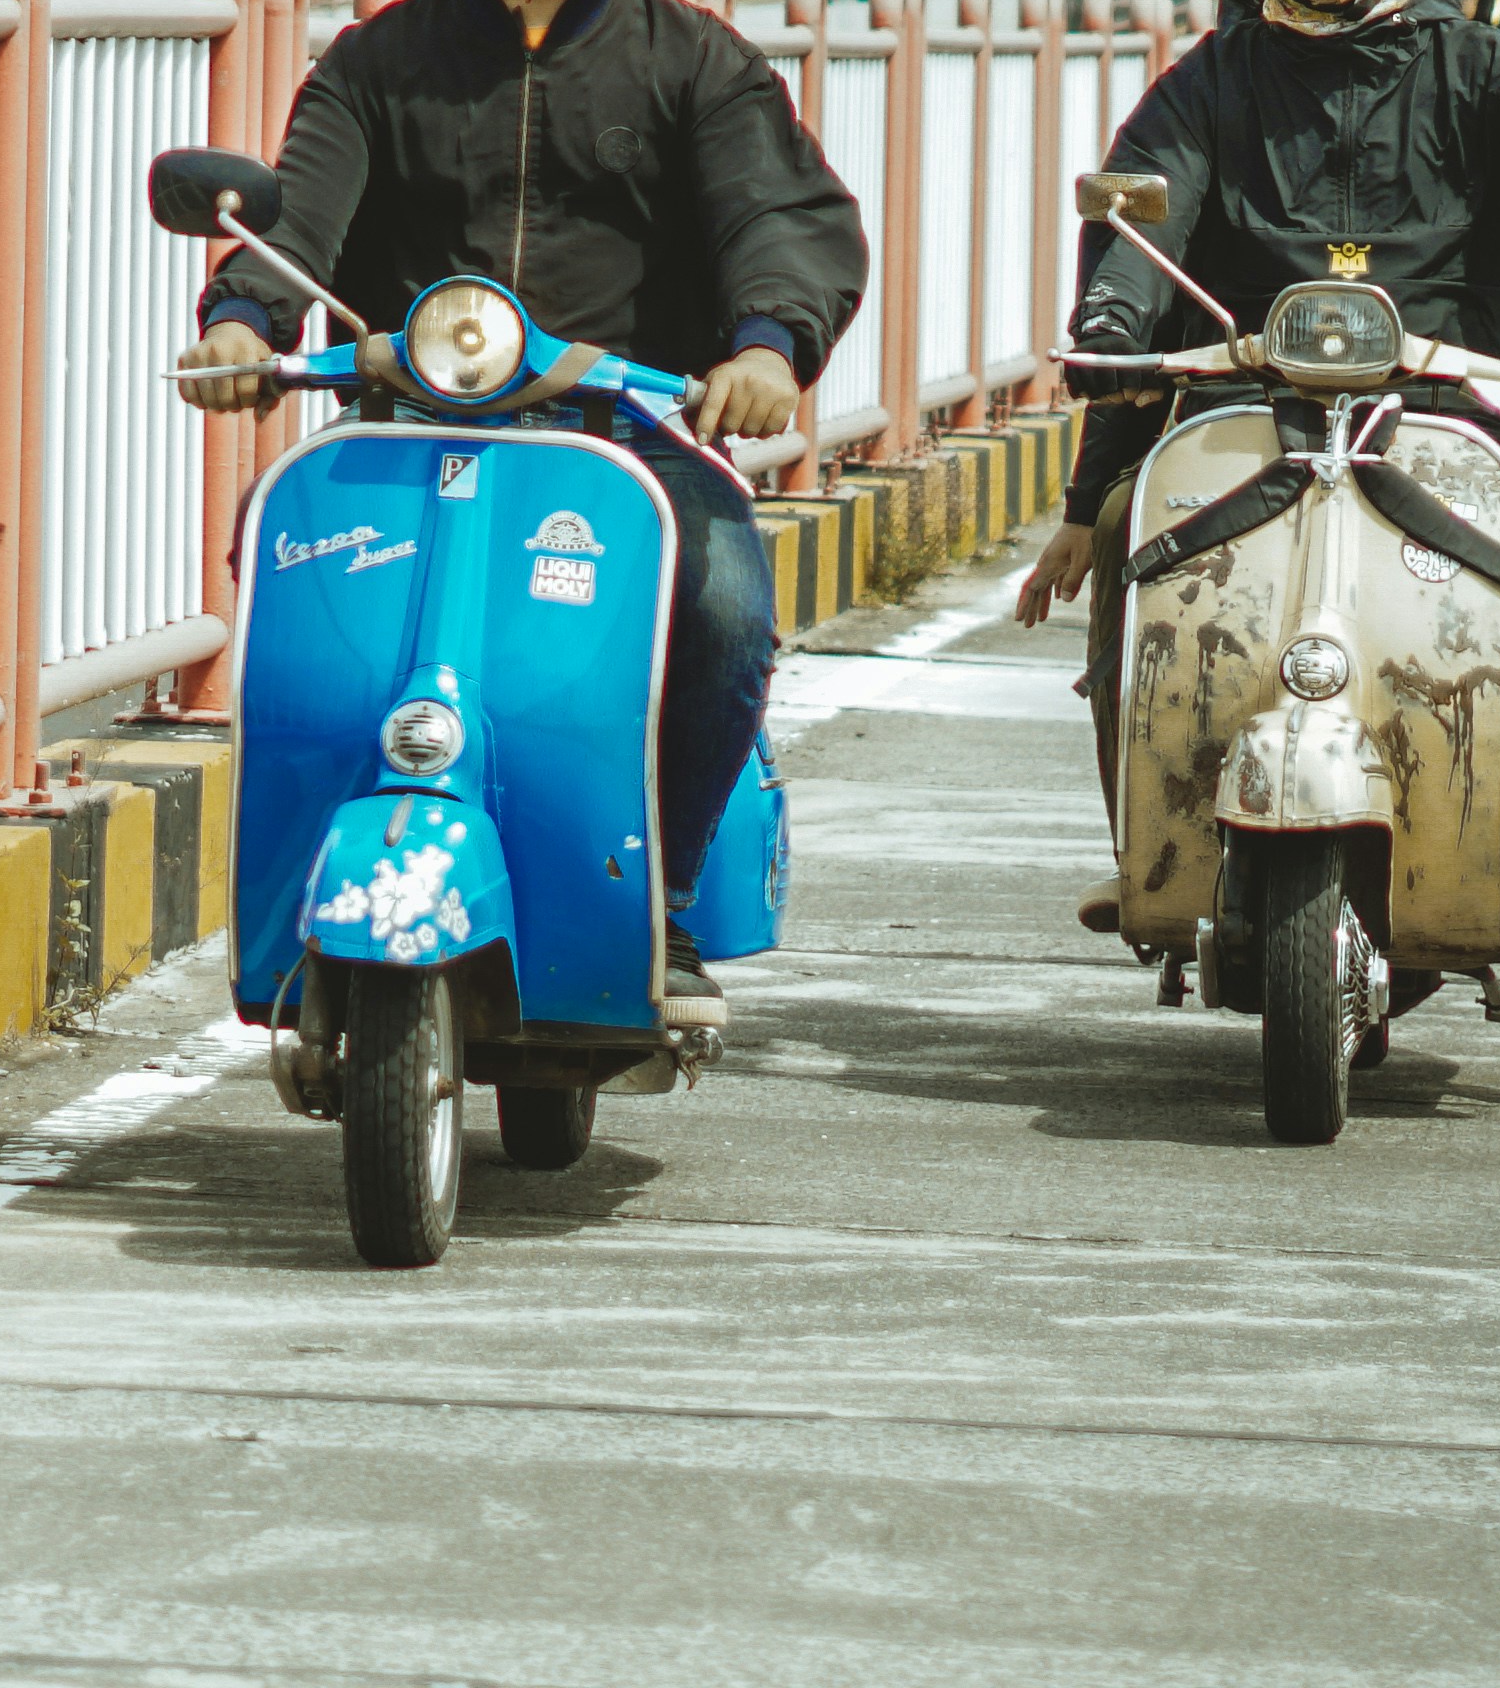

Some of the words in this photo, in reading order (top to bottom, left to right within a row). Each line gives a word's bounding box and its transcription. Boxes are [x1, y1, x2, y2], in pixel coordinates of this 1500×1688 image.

[444, 457, 464, 481] P
[275, 525, 385, 571] Vespa
[537, 557, 593, 581] LIQUI
[535, 575, 592, 599] MOLY
